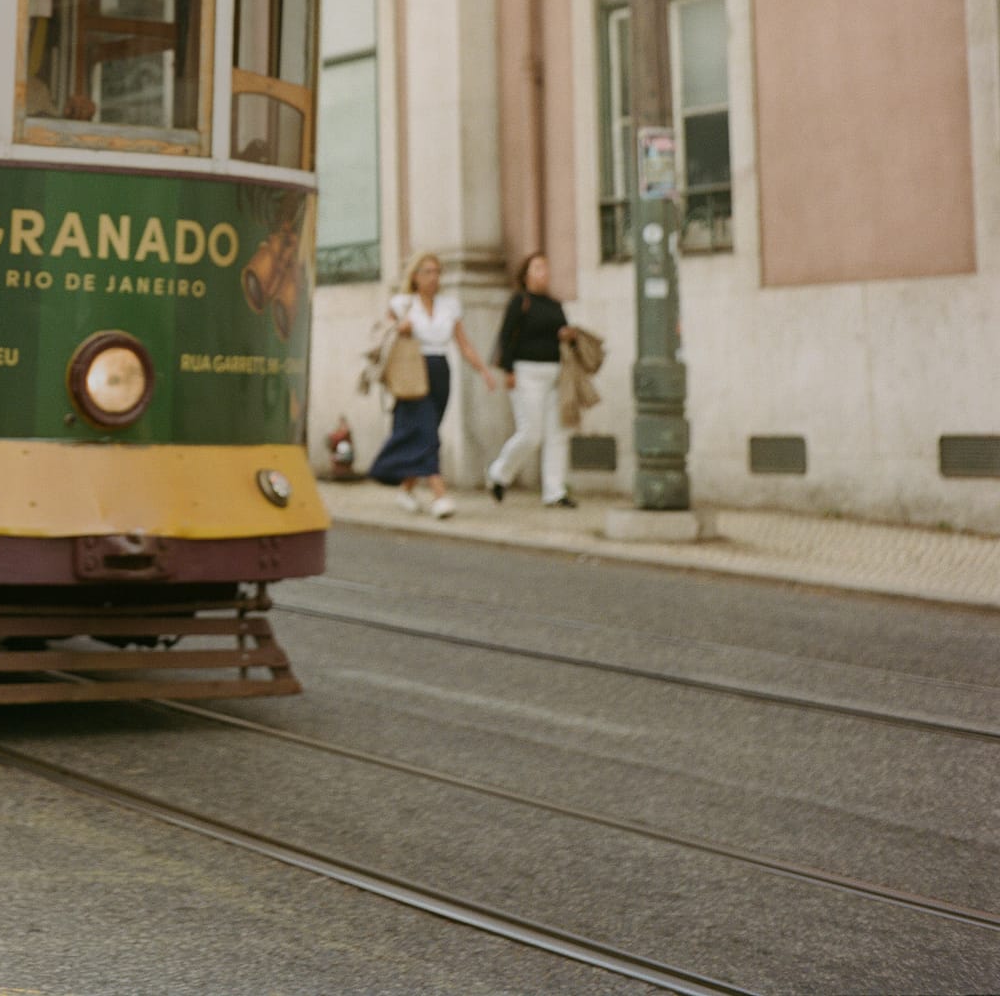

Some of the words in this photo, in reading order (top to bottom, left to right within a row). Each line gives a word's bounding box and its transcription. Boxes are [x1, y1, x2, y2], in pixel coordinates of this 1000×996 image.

[5, 270, 53, 289] RIO
[64, 272, 96, 291] DE
[105, 275, 206, 298] JANEIRO
[180, 353, 211, 372] RUA
